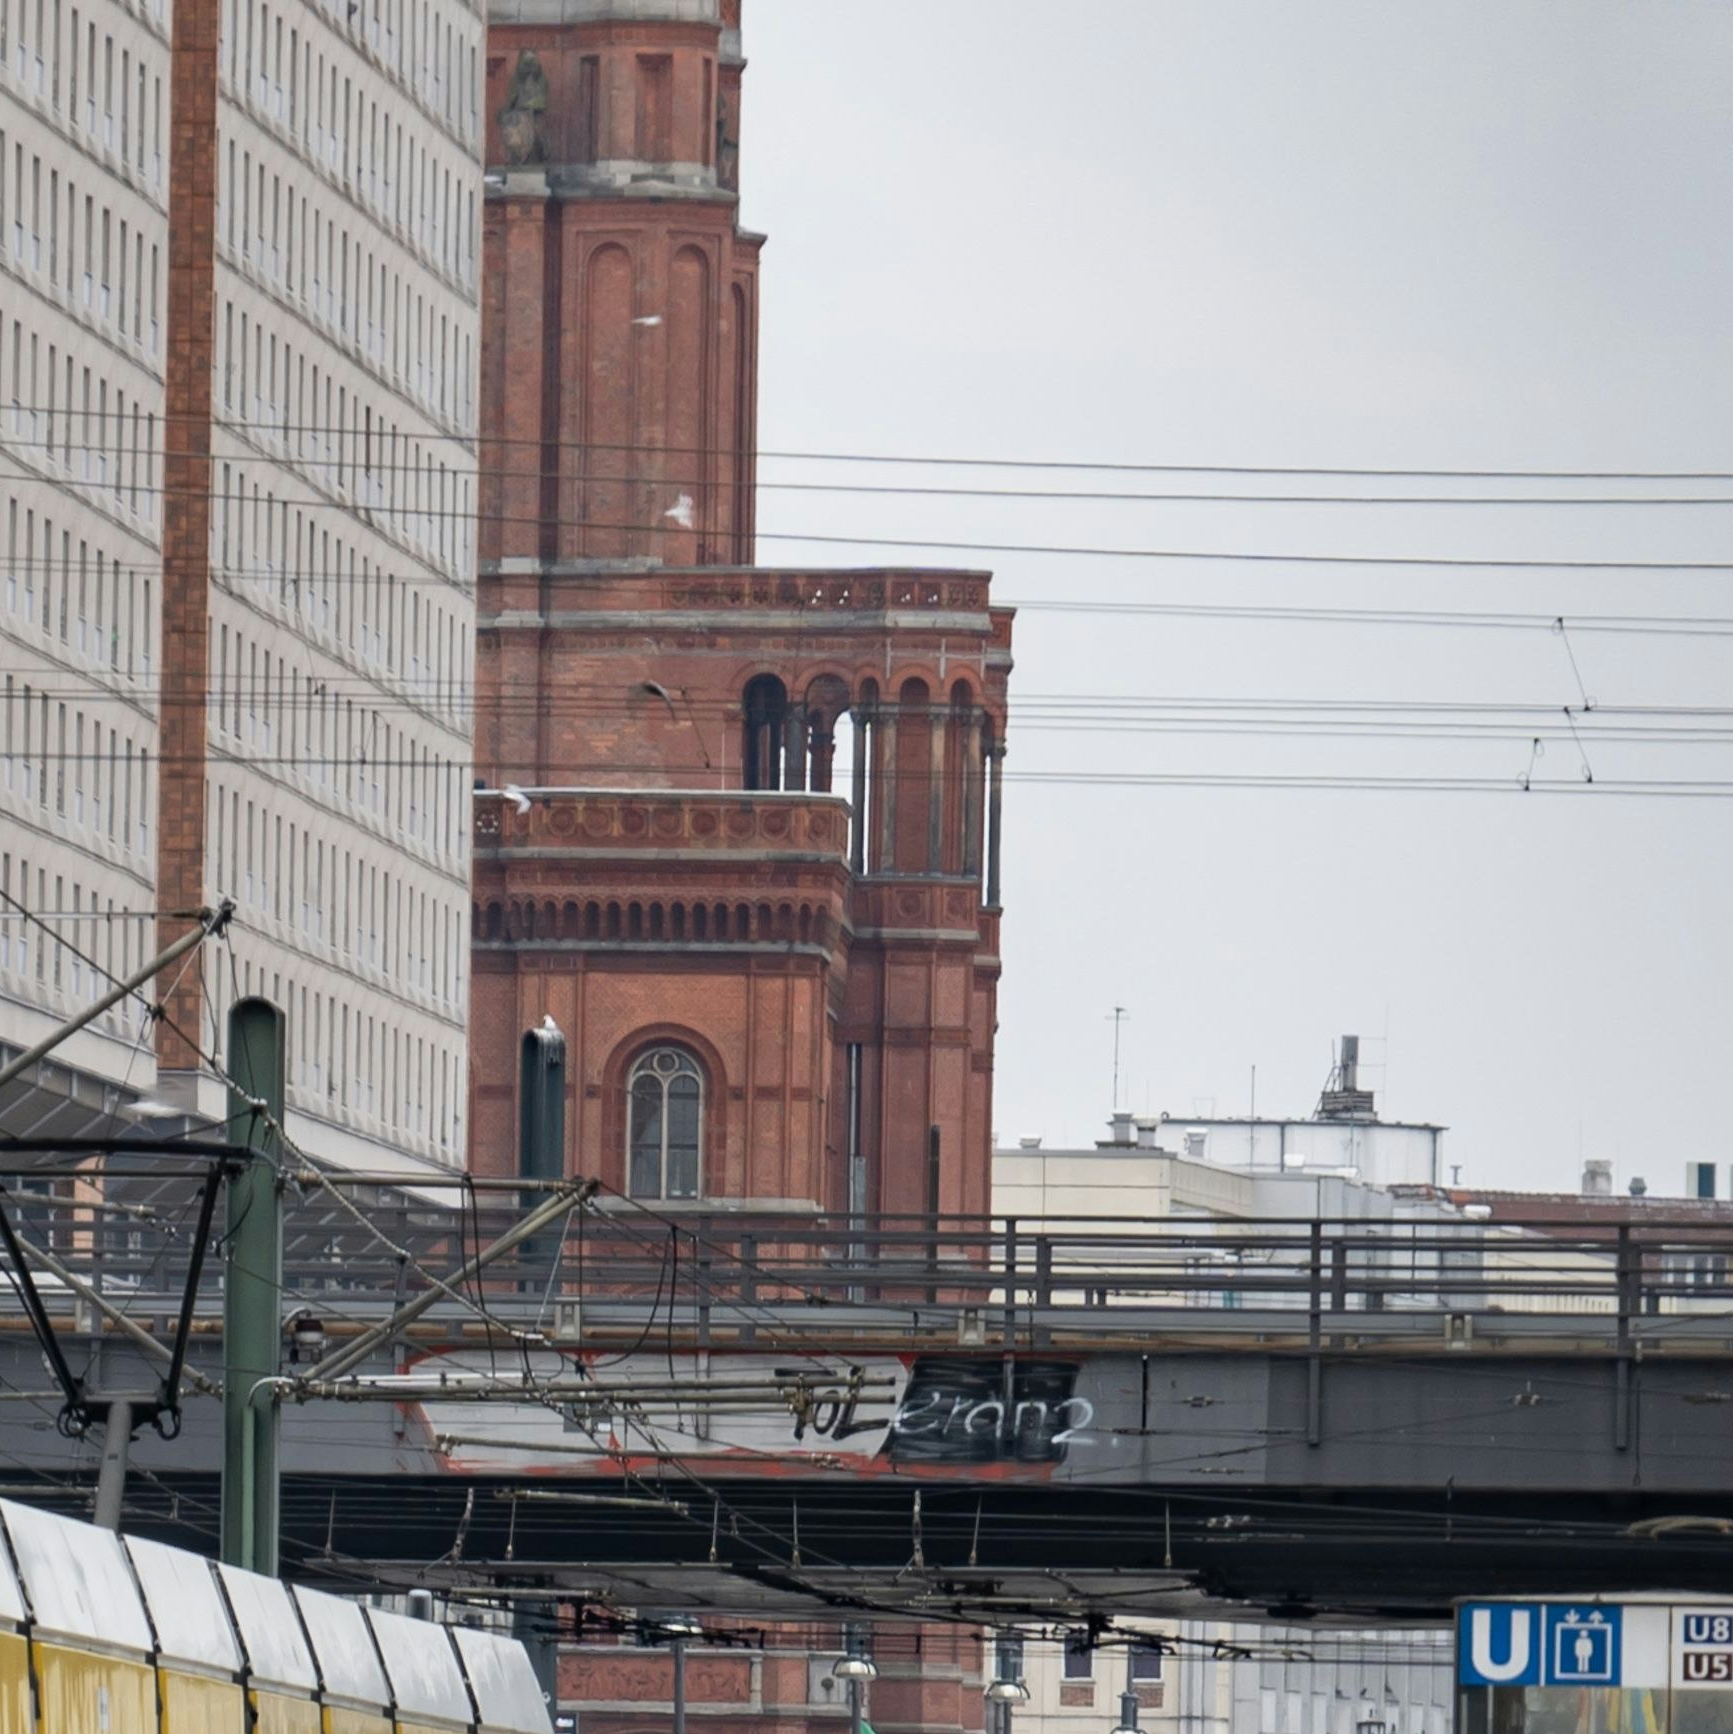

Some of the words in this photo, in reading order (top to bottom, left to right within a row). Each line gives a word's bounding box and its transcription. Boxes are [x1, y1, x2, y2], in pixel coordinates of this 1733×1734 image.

[1689, 1616, 1730, 1642] U8
[1471, 1609, 1531, 1681] U
[1687, 1654, 1729, 1680] U5
